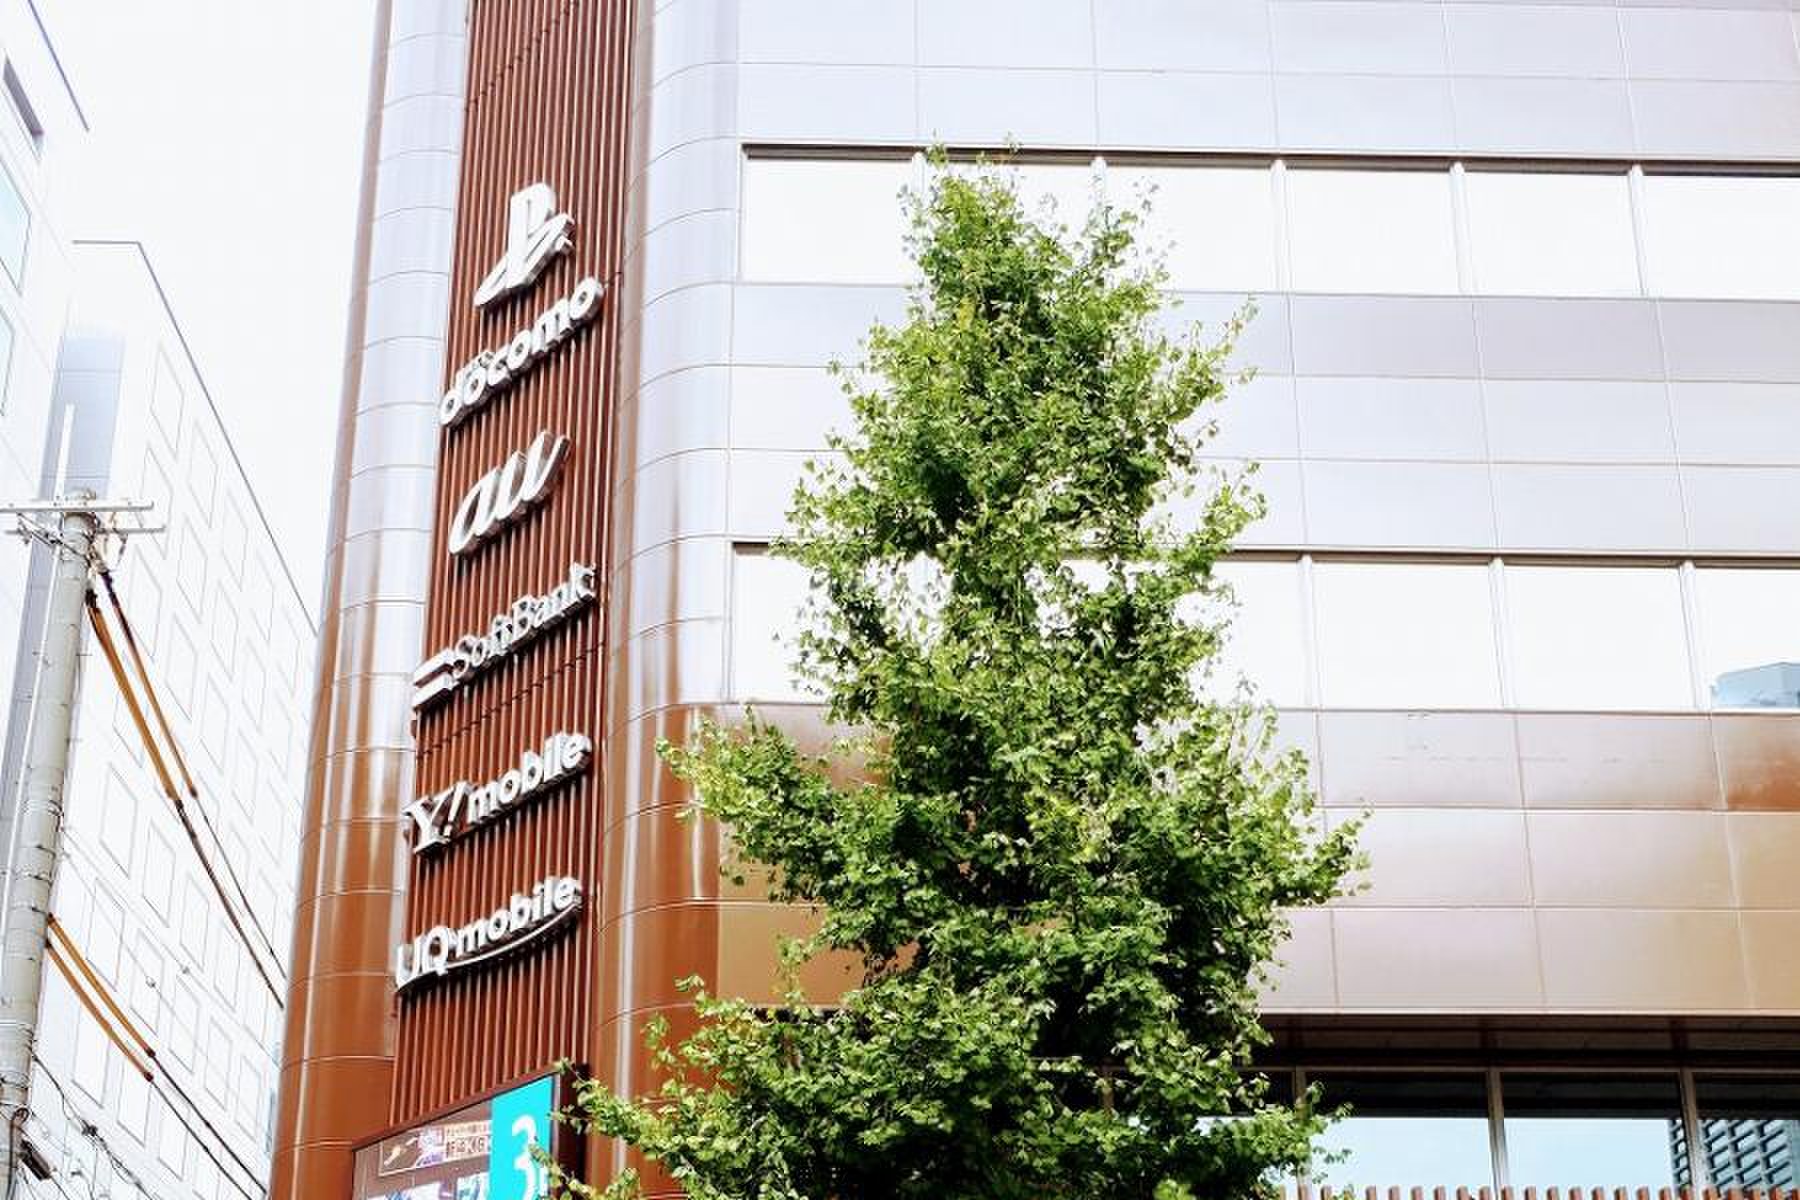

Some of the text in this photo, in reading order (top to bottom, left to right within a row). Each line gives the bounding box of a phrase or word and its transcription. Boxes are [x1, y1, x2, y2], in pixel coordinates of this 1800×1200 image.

[440, 277, 603, 427] docomo
[448, 430, 569, 554] au
[451, 562, 596, 680] SoftBank
